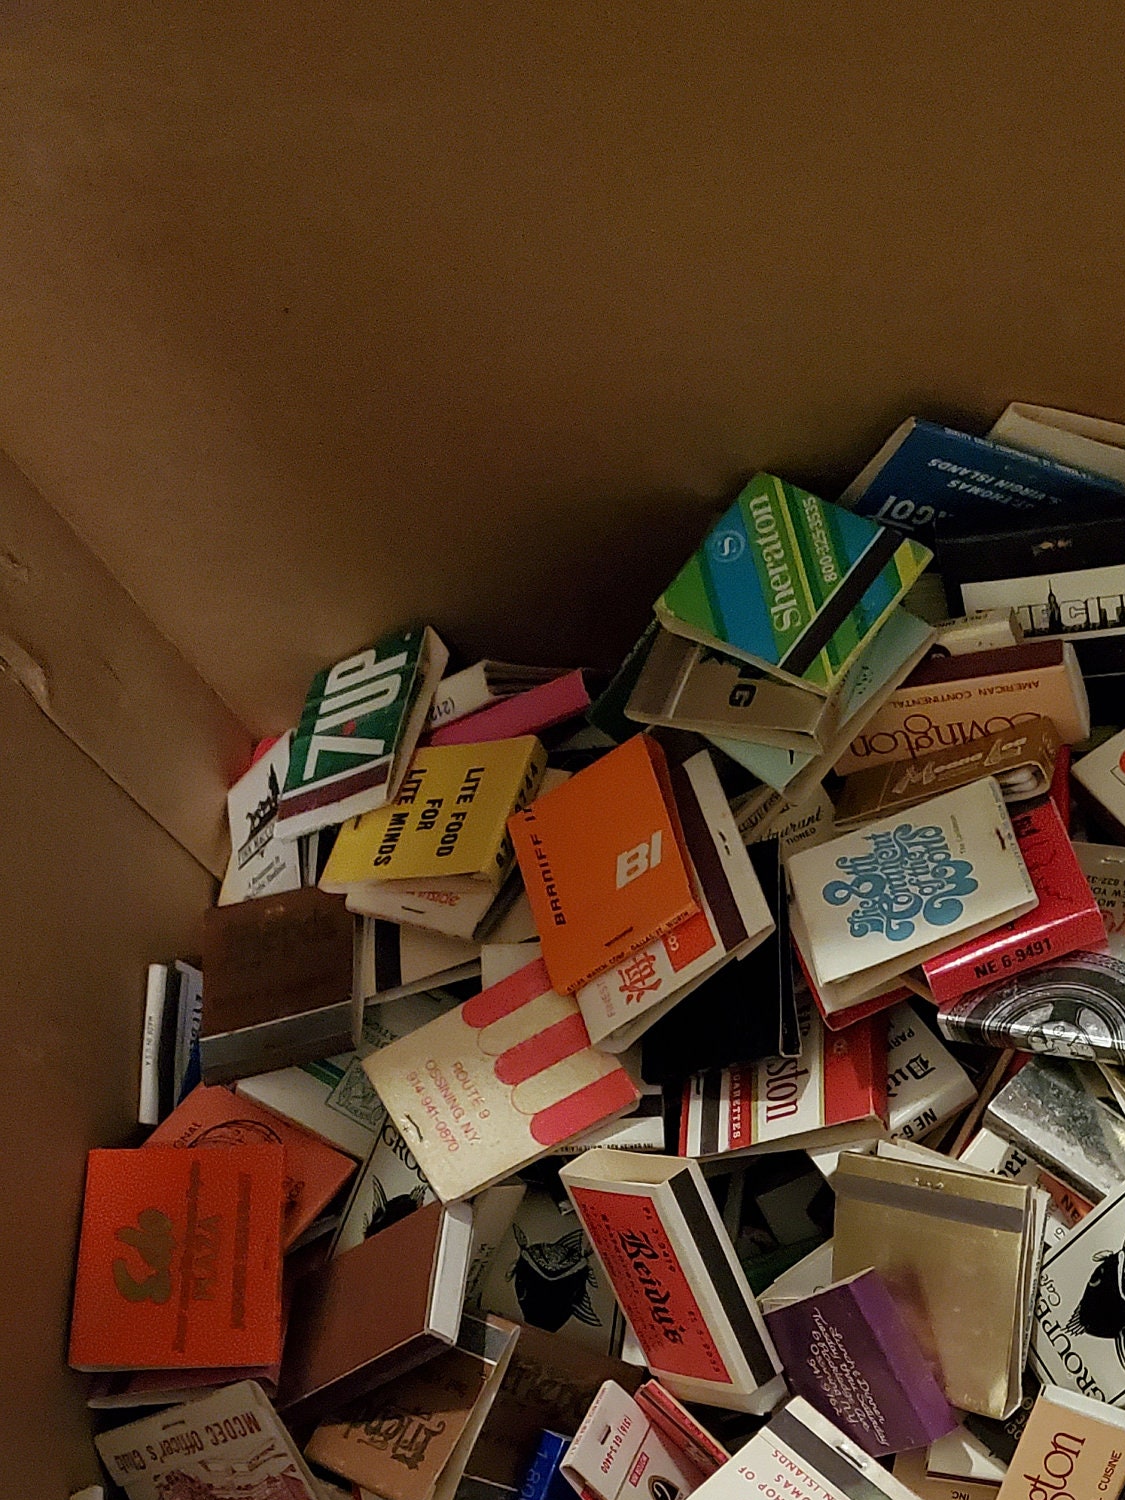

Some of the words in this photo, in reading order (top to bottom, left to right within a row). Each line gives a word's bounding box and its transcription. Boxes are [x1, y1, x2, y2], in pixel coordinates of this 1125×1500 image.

[927, 457, 988, 486] ISLANDS
[749, 494, 801, 632] Sheraton
[891, 690, 972, 710] CONTINENTAL
[978, 679, 1040, 698] AMERICAN
[303, 648, 407, 780] 7UP
[402, 768, 427, 805] LITE
[464, 767, 485, 804] LITE
[416, 798, 444, 832] FOR
[435, 812, 467, 858] FOOD
[374, 812, 410, 868] MINDS
[538, 834, 567, 926] BRANIFF
[974, 961, 1001, 979] NE
[1002, 937, 1052, 969] 6-9491
[425, 1059, 467, 1125] OSSINING,
[451, 1060, 481, 1104] ROUTE
[481, 1108, 491, 1121] 9
[421, 1095, 460, 1152] 941-0870
[617, 1227, 685, 1346] Reidy's
[206, 1412, 262, 1448] MCDEC
[737, 1464, 756, 1482] OF
[771, 1449, 829, 1498] ISLANDS
[1097, 1449, 1123, 1492] CUISINE
